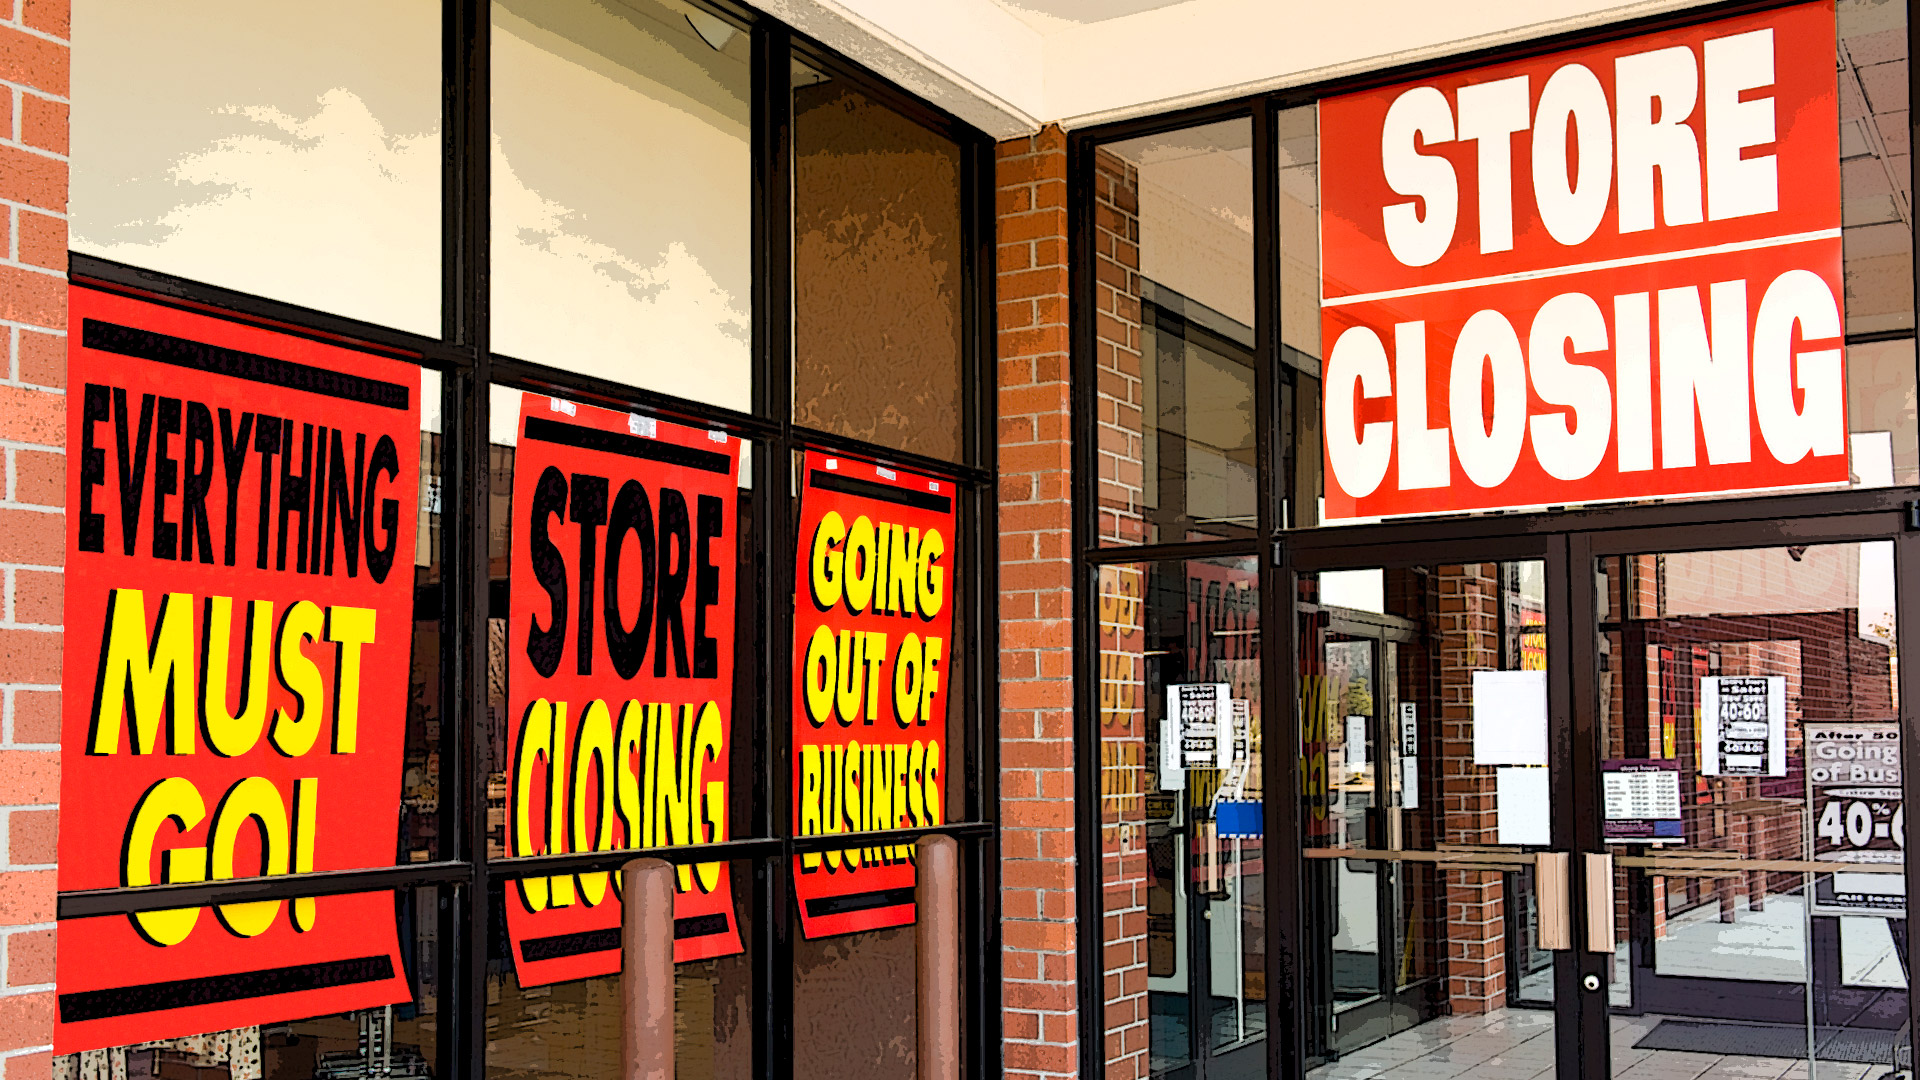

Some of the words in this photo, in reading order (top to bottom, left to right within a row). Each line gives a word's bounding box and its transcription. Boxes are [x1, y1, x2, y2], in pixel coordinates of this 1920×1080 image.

[1381, 27, 1778, 267] STORE
[1325, 269, 1845, 498] CLOSING
[78, 383, 399, 584] EVERYTHING
[808, 510, 944, 621] GOING
[527, 465, 723, 680] STORE
[86, 587, 377, 758] MUST
[804, 624, 888, 728] OUT
[891, 631, 943, 728] OF
[1816, 741, 1898, 765] Going
[513, 698, 724, 912] CLOSING
[798, 739, 940, 874] BUSINESS
[1811, 762, 1842, 782] of
[1850, 764, 1898, 783] Bus
[120, 777, 319, 947] GO!
